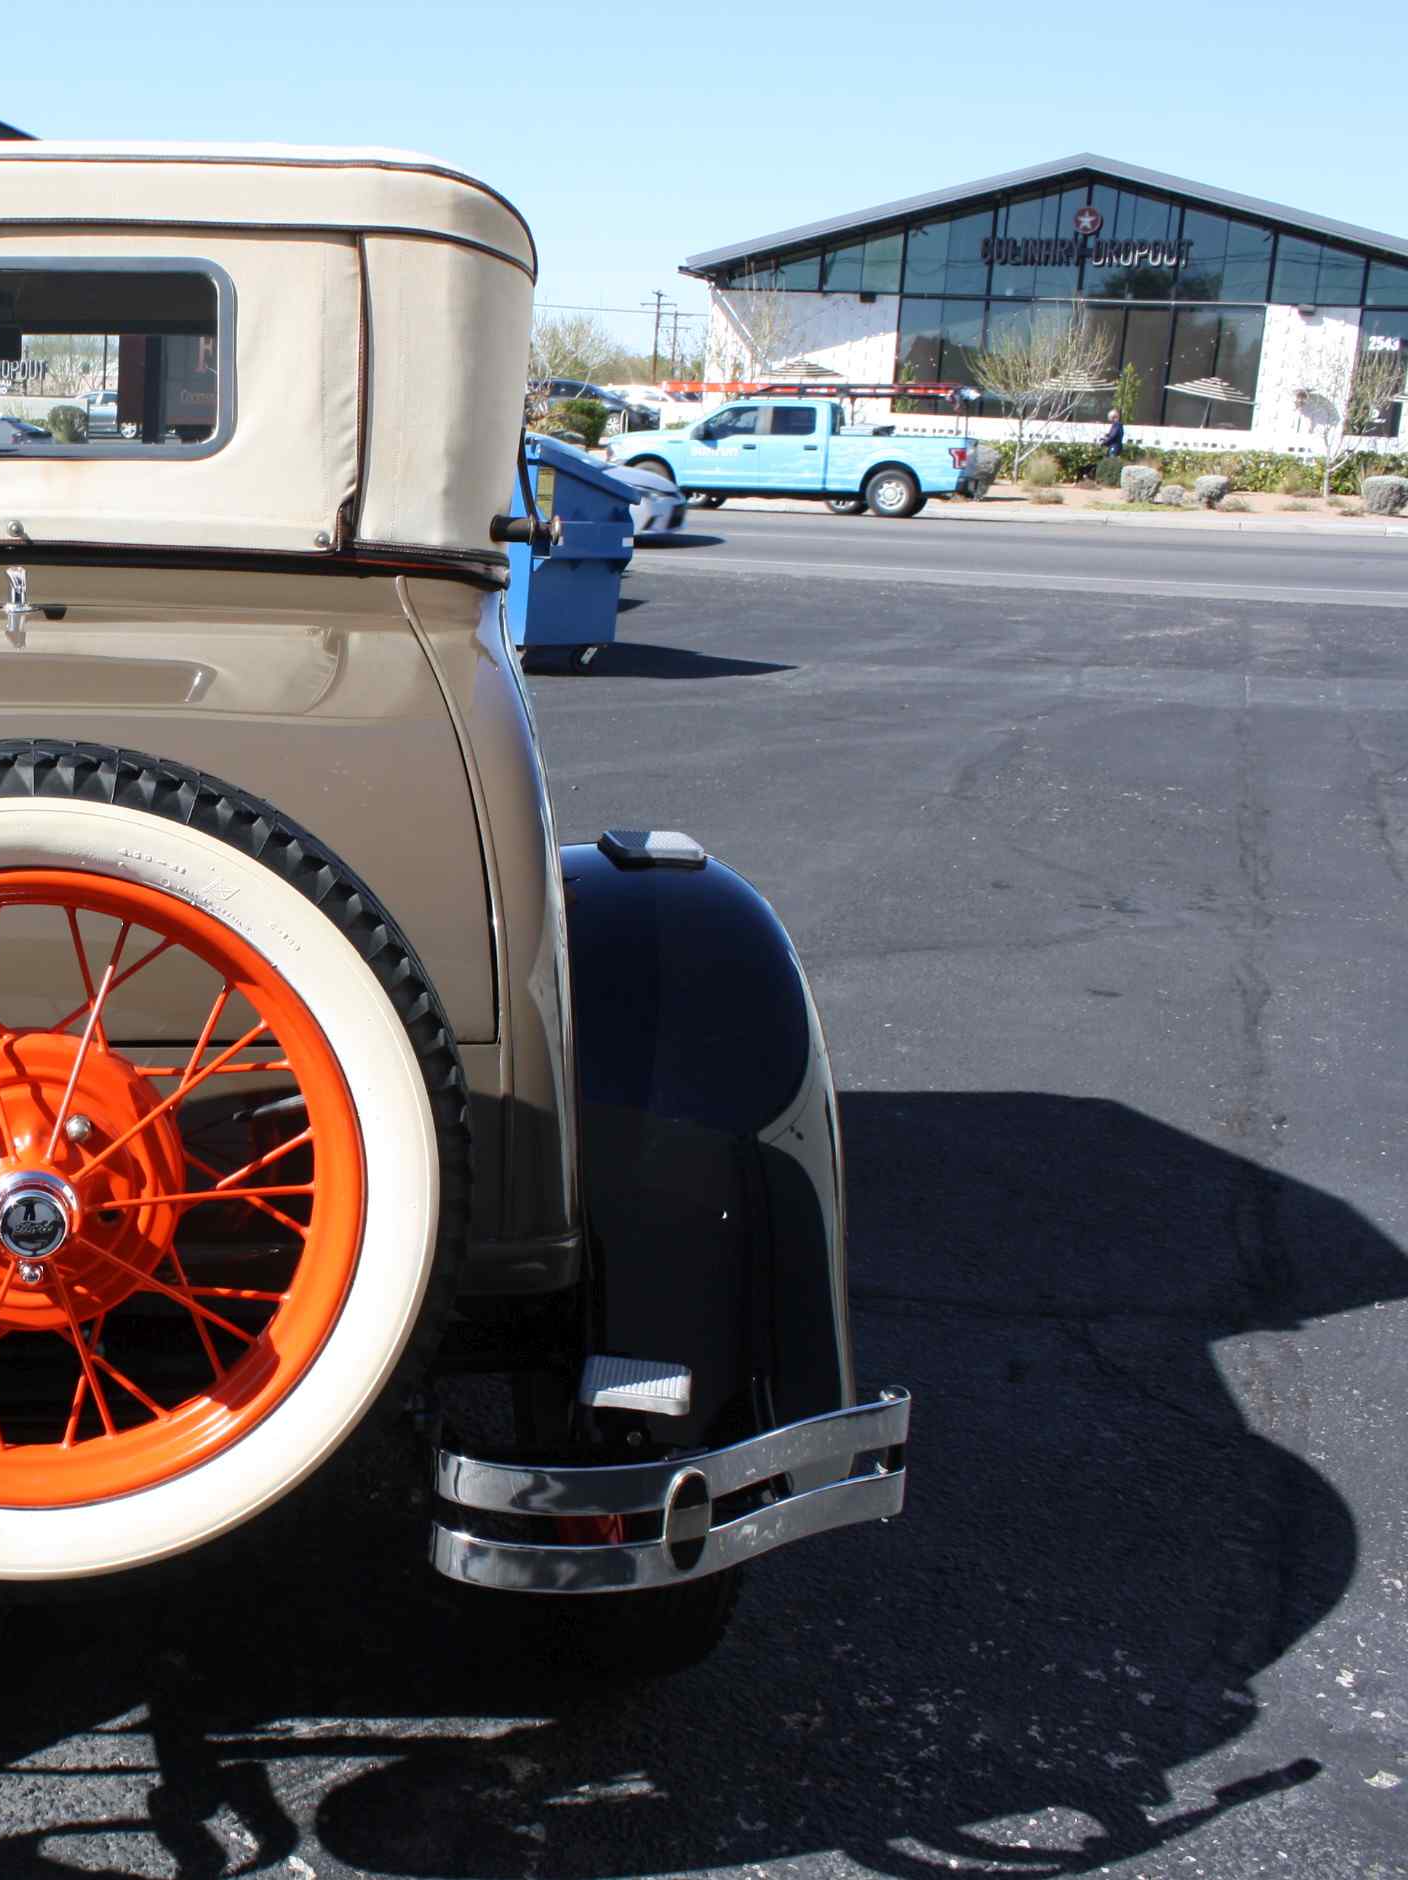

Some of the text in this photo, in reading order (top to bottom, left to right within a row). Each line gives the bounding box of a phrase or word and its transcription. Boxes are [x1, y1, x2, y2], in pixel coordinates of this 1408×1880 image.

[980, 237, 1194, 268] CULINARY DROPOUT
[1367, 335, 1400, 352] 2543
